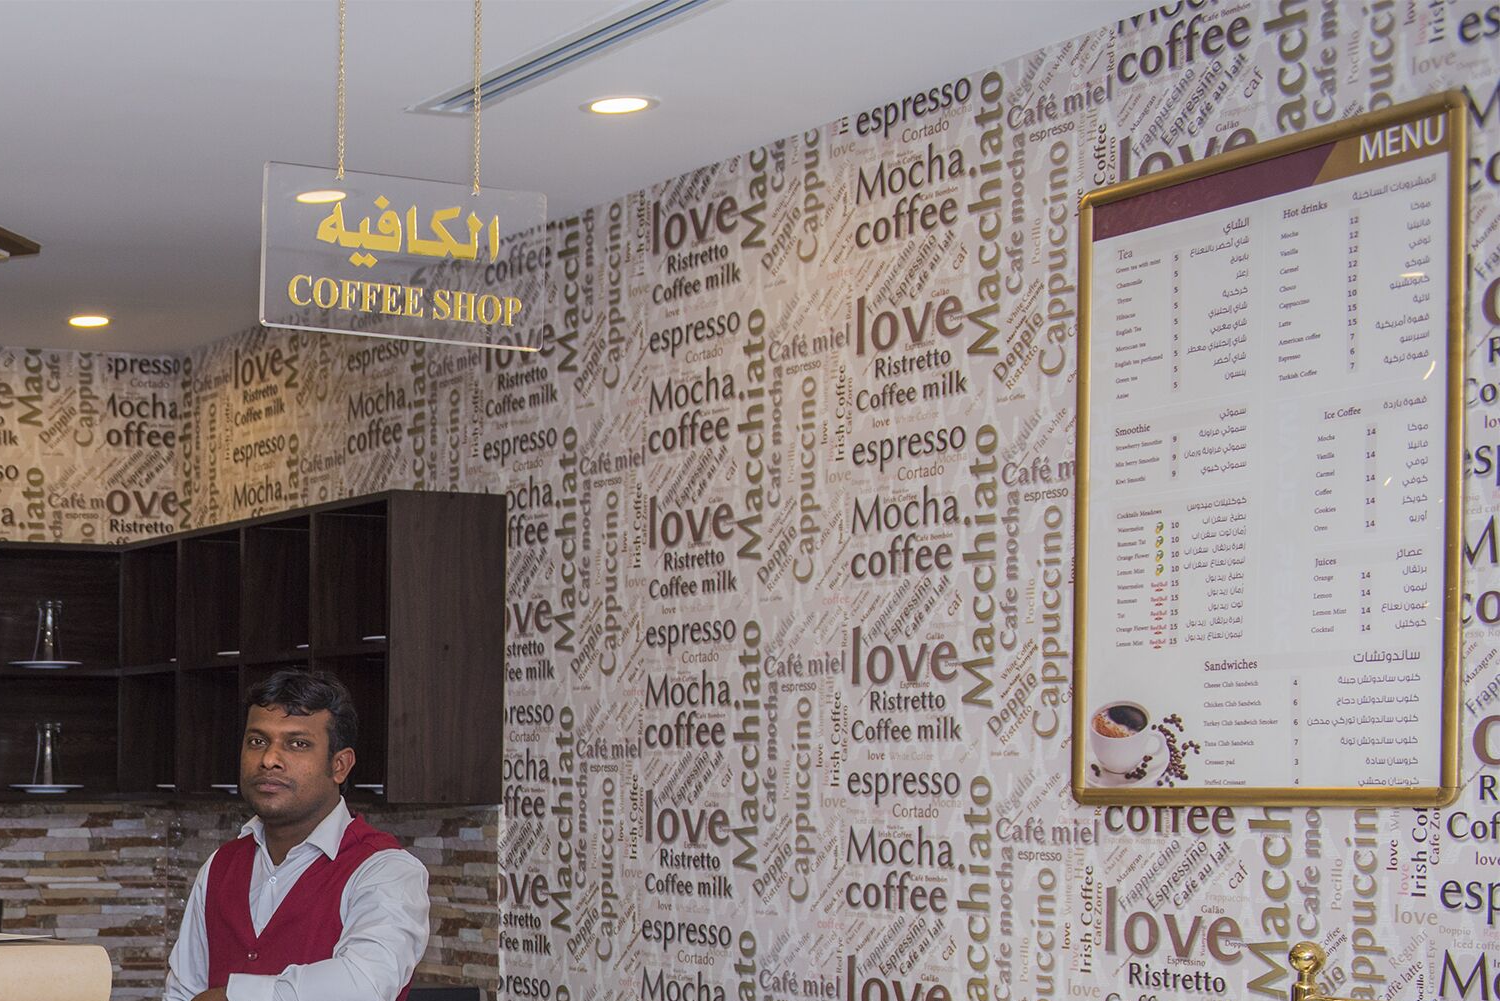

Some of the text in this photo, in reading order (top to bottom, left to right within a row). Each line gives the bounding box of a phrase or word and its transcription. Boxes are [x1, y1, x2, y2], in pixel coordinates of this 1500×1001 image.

[1117, 15, 1251, 86] coffee
[856, 76, 972, 140] espresso
[1007, 75, 1113, 132] Café miel
[901, 119, 950, 144] Cortado
[1029, 120, 1075, 143] espresso
[1357, 113, 1446, 164] MENU
[856, 142, 964, 204] Mocha
[652, 195, 739, 255] love
[855, 191, 959, 250] coffee
[967, 70, 1004, 356] Macchiato
[1223, 217, 1250, 235] الشاي
[1283, 201, 1328, 219] Hot drinks
[1350, 216, 1359, 224] 12
[316, 194, 499, 268] الكافيه
[952, 242, 970, 271] caf
[1038, 140, 1074, 376] Cappuccino
[1117, 249, 1133, 260] Tea
[288, 273, 523, 327] COFFEE SHOP
[651, 263, 742, 305] Coffee milk
[650, 311, 741, 359] espresso
[856, 294, 964, 357] love
[874, 348, 952, 380] Ristretto
[1115, 424, 1151, 437] Smoothie
[1324, 406, 1361, 420] Ice Coffee
[1367, 428, 1376, 436] 14
[232, 434, 286, 465] espresso
[346, 416, 403, 455] coffee
[1315, 558, 1337, 568] Juices
[645, 618, 737, 655] espresso
[1353, 649, 1421, 663] ساندوتشات
[1204, 659, 1258, 672] Sandwiches
[646, 670, 731, 709] Mocha
[645, 789, 731, 846] love
[1106, 884, 1245, 964] love
[1128, 961, 1227, 996] Ristretto
